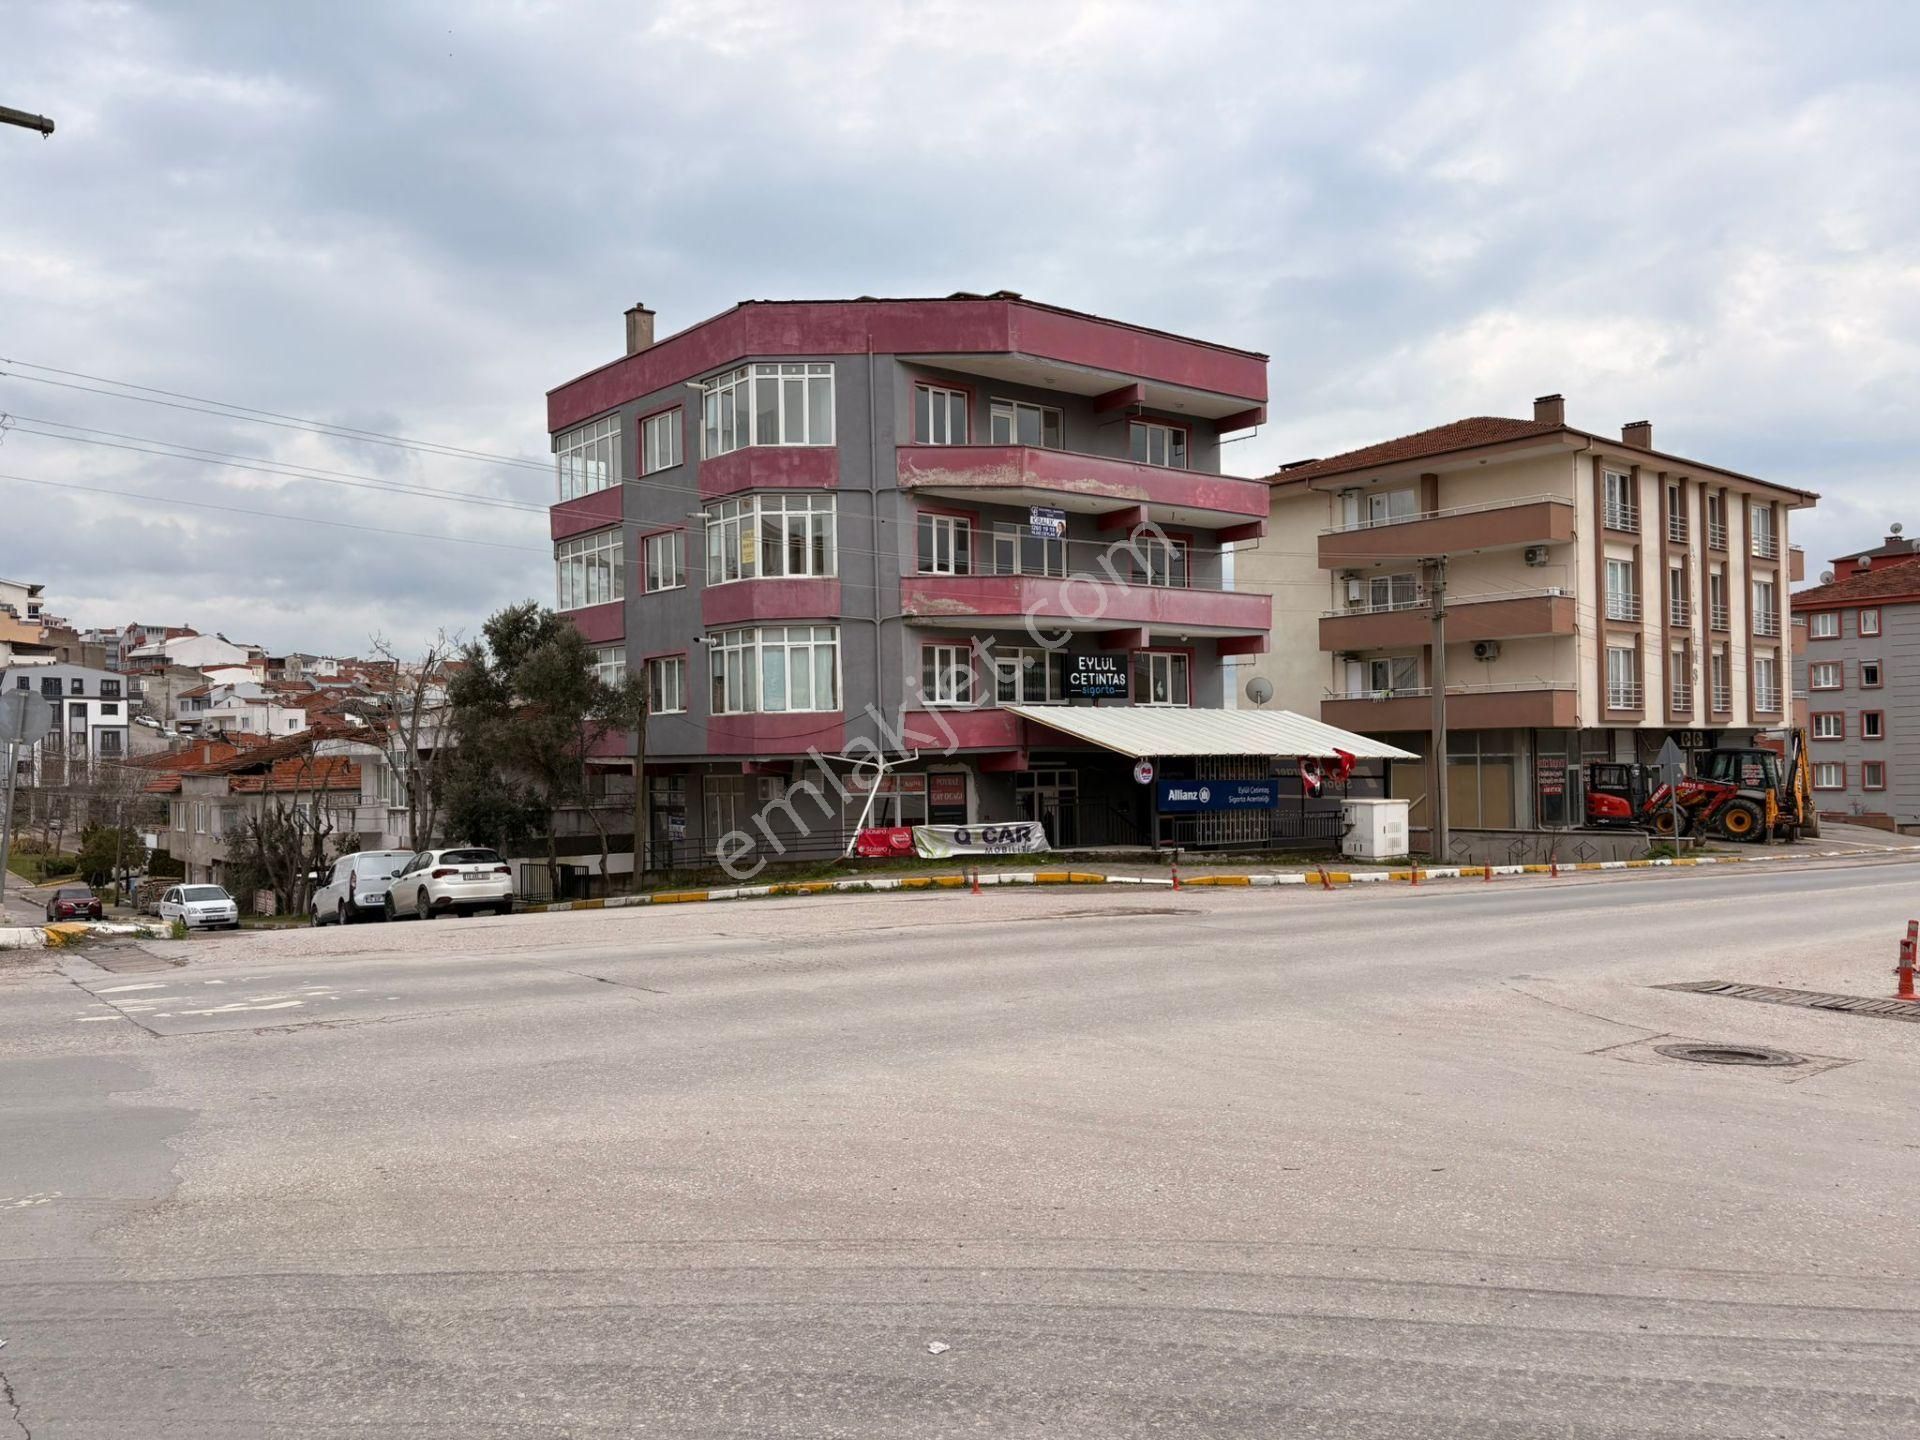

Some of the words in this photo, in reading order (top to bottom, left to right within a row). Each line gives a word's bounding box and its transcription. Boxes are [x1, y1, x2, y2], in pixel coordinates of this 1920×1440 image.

[1078, 656, 1117, 670] EYLÜL
[1082, 686, 1115, 696] sigorta
[1168, 789, 1198, 801] Allianz
[954, 828, 972, 845] Q
[982, 826, 1031, 845] CAR
